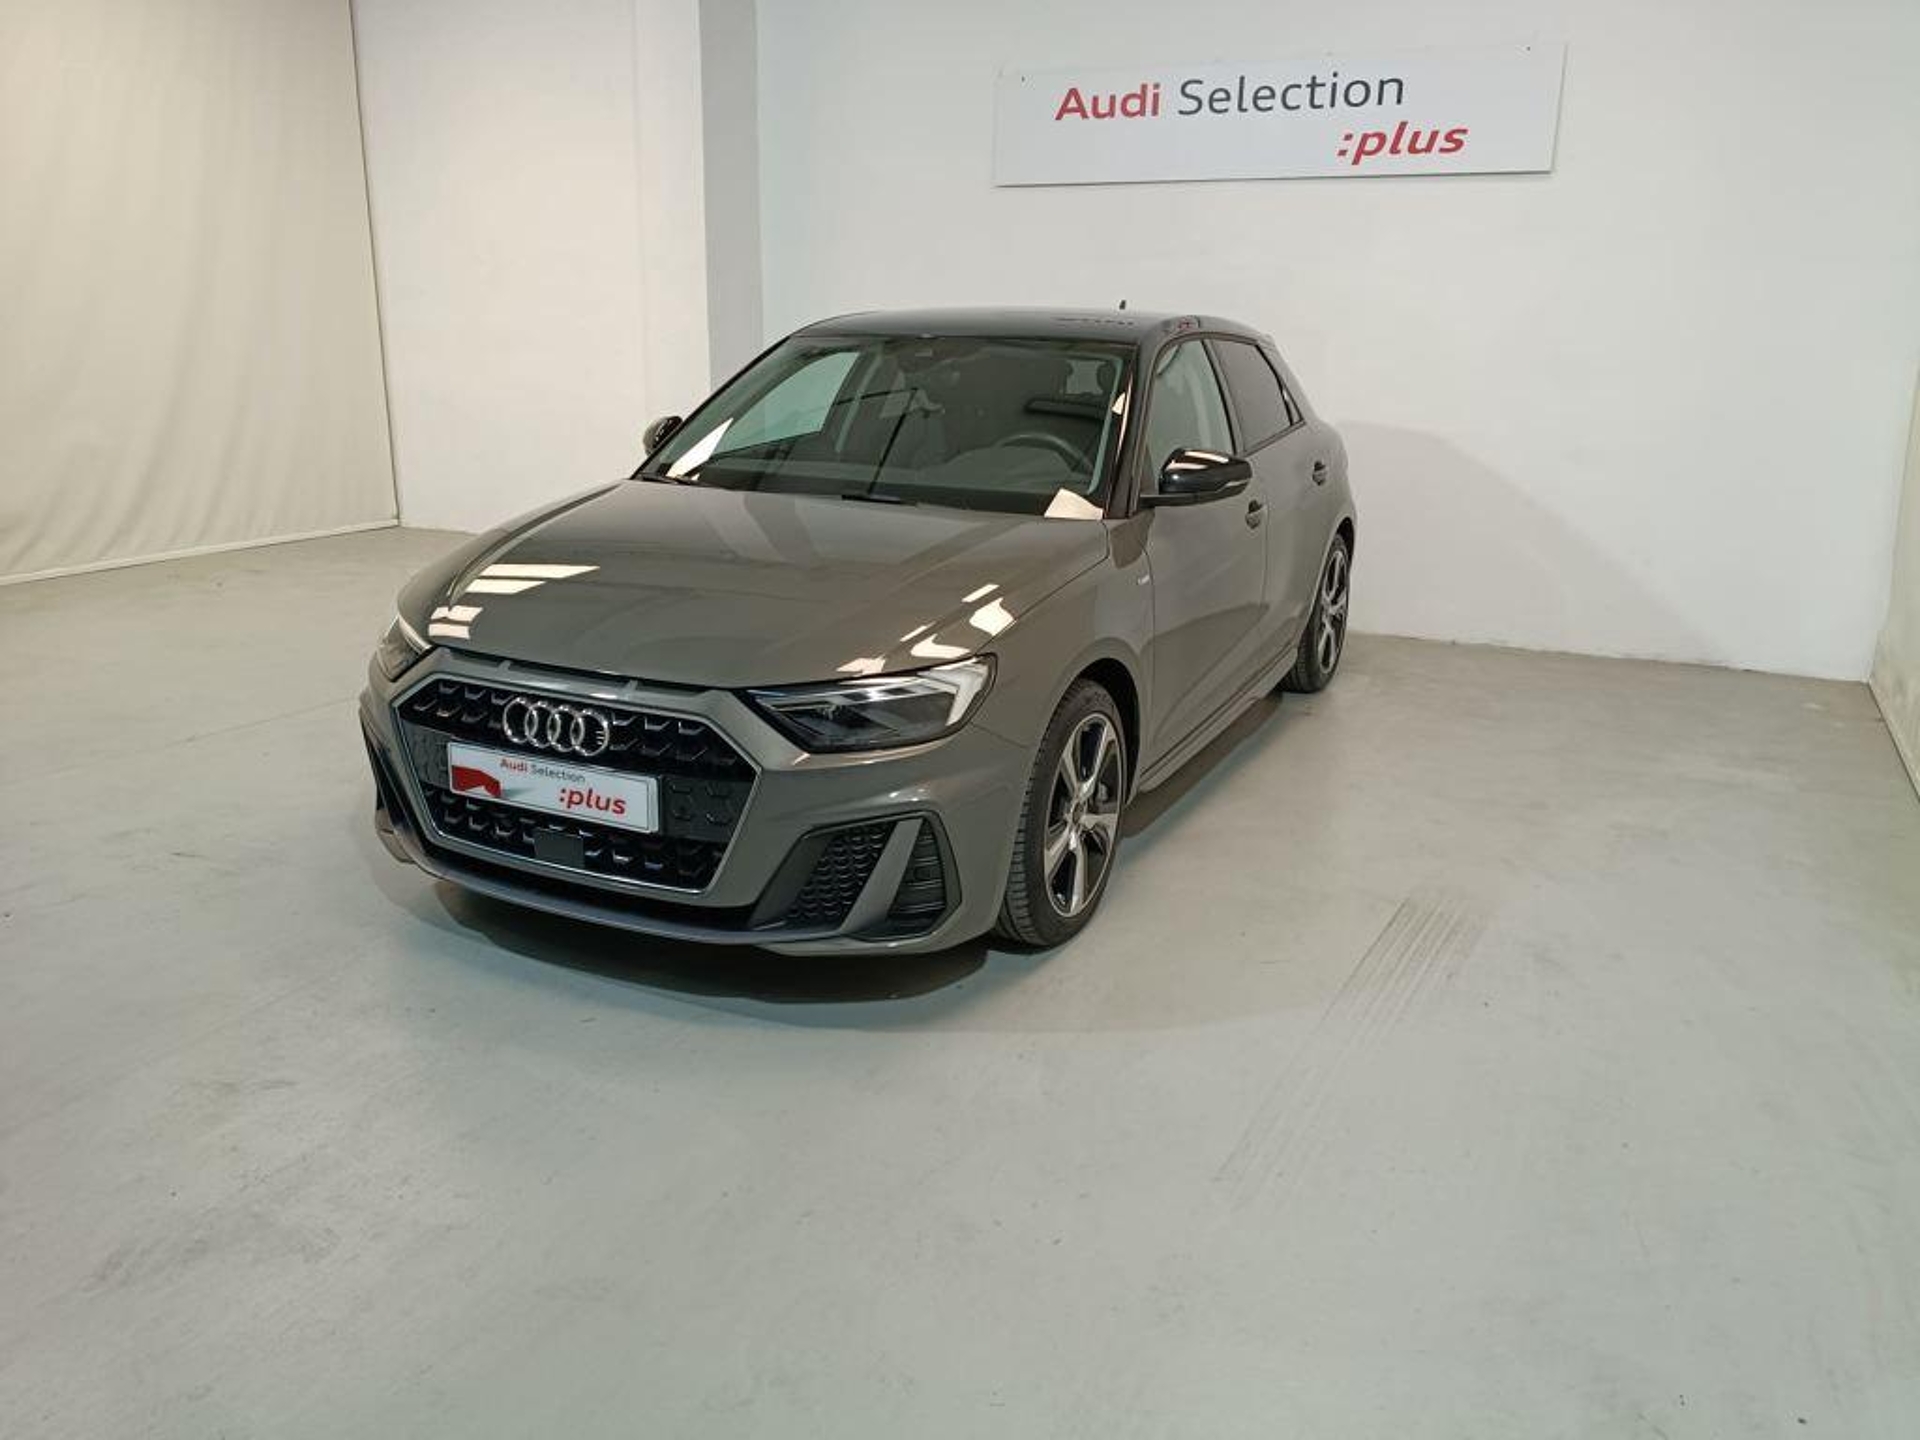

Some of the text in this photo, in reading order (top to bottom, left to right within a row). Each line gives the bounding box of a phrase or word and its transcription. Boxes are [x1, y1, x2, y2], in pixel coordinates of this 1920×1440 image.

[1055, 71, 1404, 120] Audi Selection
[1337, 121, 1468, 165] :plus
[500, 758, 586, 783] Audi Selection
[559, 787, 627, 815] :plus
